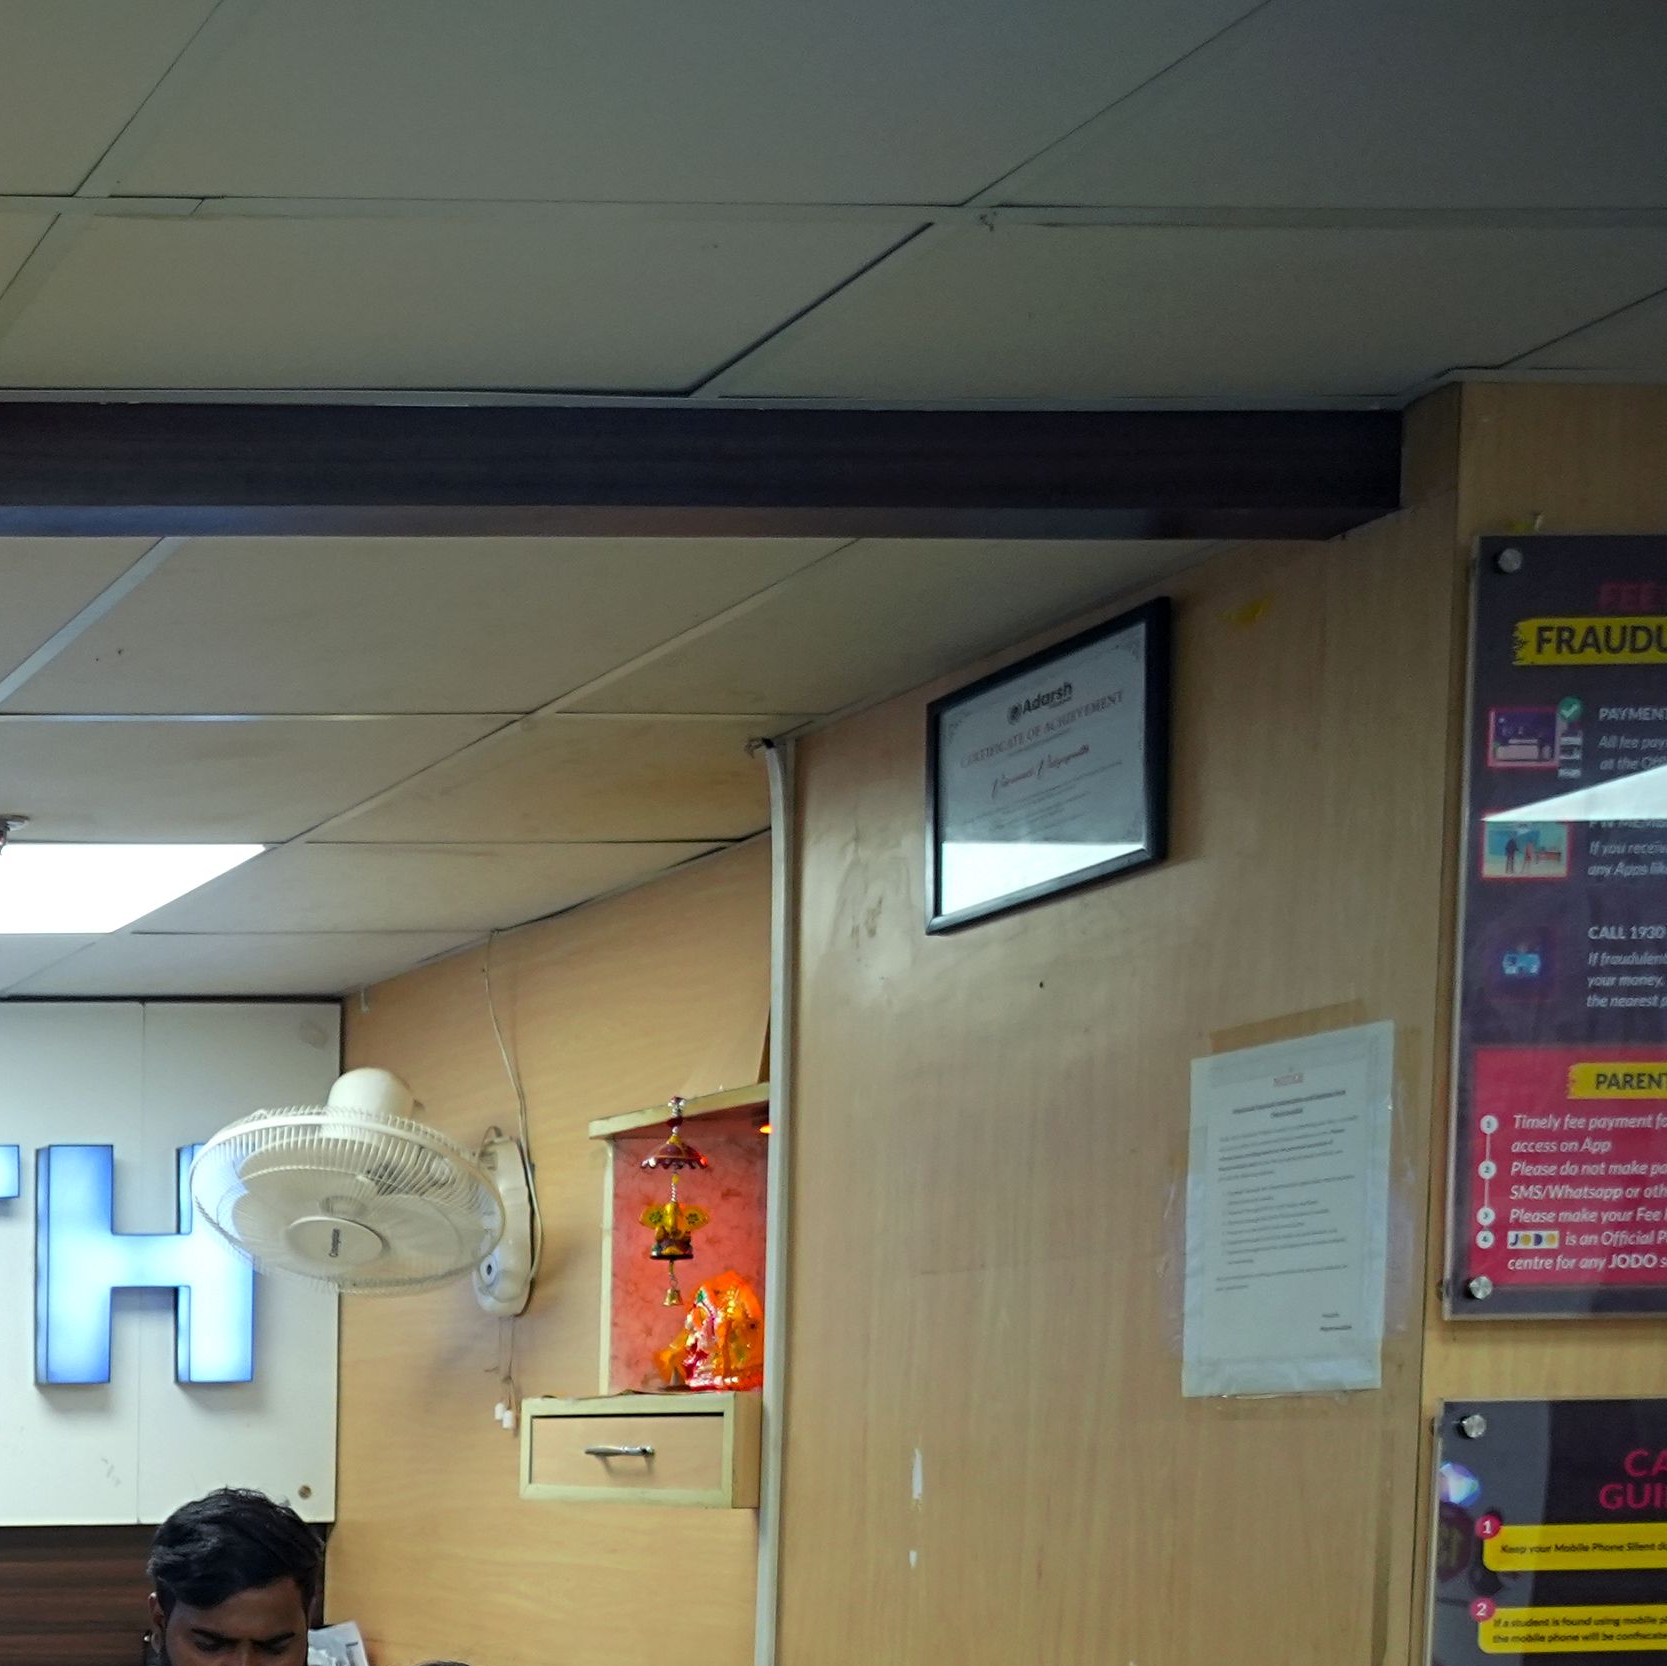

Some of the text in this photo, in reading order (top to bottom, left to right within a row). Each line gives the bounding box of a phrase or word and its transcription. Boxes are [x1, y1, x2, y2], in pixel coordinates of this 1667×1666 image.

[1022, 681, 1073, 714] Adarsh
[1587, 926, 1626, 940] CALL
[1513, 1113, 1560, 1131] Timely
[1563, 1113, 1585, 1130] fee
[1588, 1114, 1653, 1131] payment
[1511, 1136, 1611, 1154] access on App
[1511, 1161, 1557, 1176] Please
[1560, 1160, 1579, 1175] do
[1581, 1161, 1606, 1175] not
[1608, 1160, 1646, 1175] make
[1510, 1184, 1623, 1201] SMS/Whatsapp
[1509, 1208, 1556, 1223] Please
[1558, 1208, 1597, 1223] make
[1601, 1210, 1633, 1226] your
[1636, 1207, 1661, 1222] Fee
[1565, 1231, 1577, 1246] is
[1579, 1234, 1599, 1246] an
[1601, 1231, 1655, 1247] Official
[1507, 1256, 1553, 1270] centre
[1555, 1254, 1575, 1271] for
[1579, 1258, 1607, 1272] any
[1608, 1253, 1658, 1269] JODO
[1483, 1519, 1492, 1534] 1
[1555, 1542, 1589, 1552] Mobile
[1591, 1543, 1624, 1552] Phone
[1477, 1602, 1487, 1616] 2
[1511, 1618, 1549, 1627] student
[1561, 1616, 1592, 1626] found
[1511, 1632, 1545, 1642] mobile
[1547, 1632, 1581, 1644] phone
